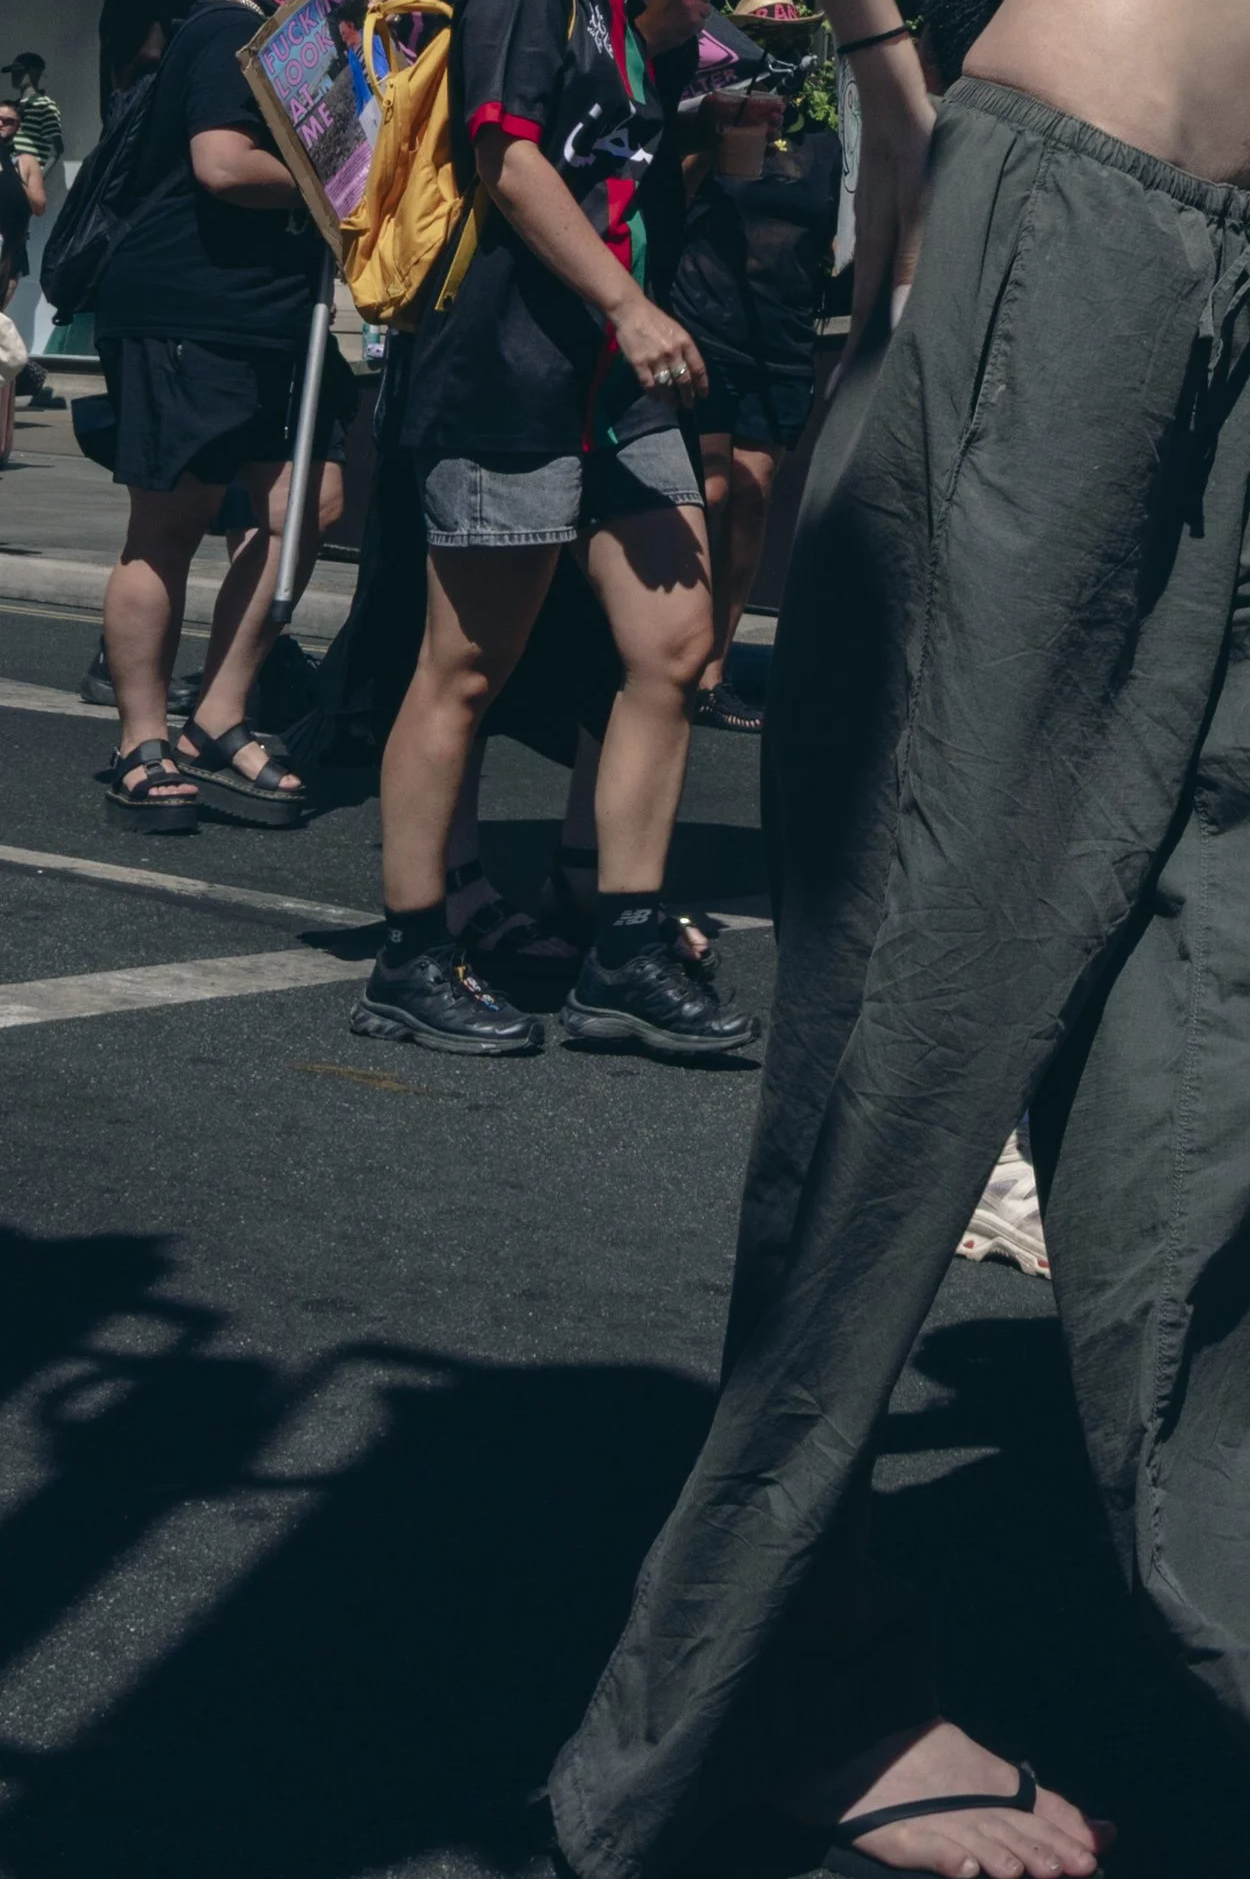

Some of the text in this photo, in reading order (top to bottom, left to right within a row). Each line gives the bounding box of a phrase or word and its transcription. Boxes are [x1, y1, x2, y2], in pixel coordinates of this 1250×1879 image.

[274, 23, 336, 99] LOOK
[289, 82, 315, 125] AT
[299, 101, 335, 149] ME
